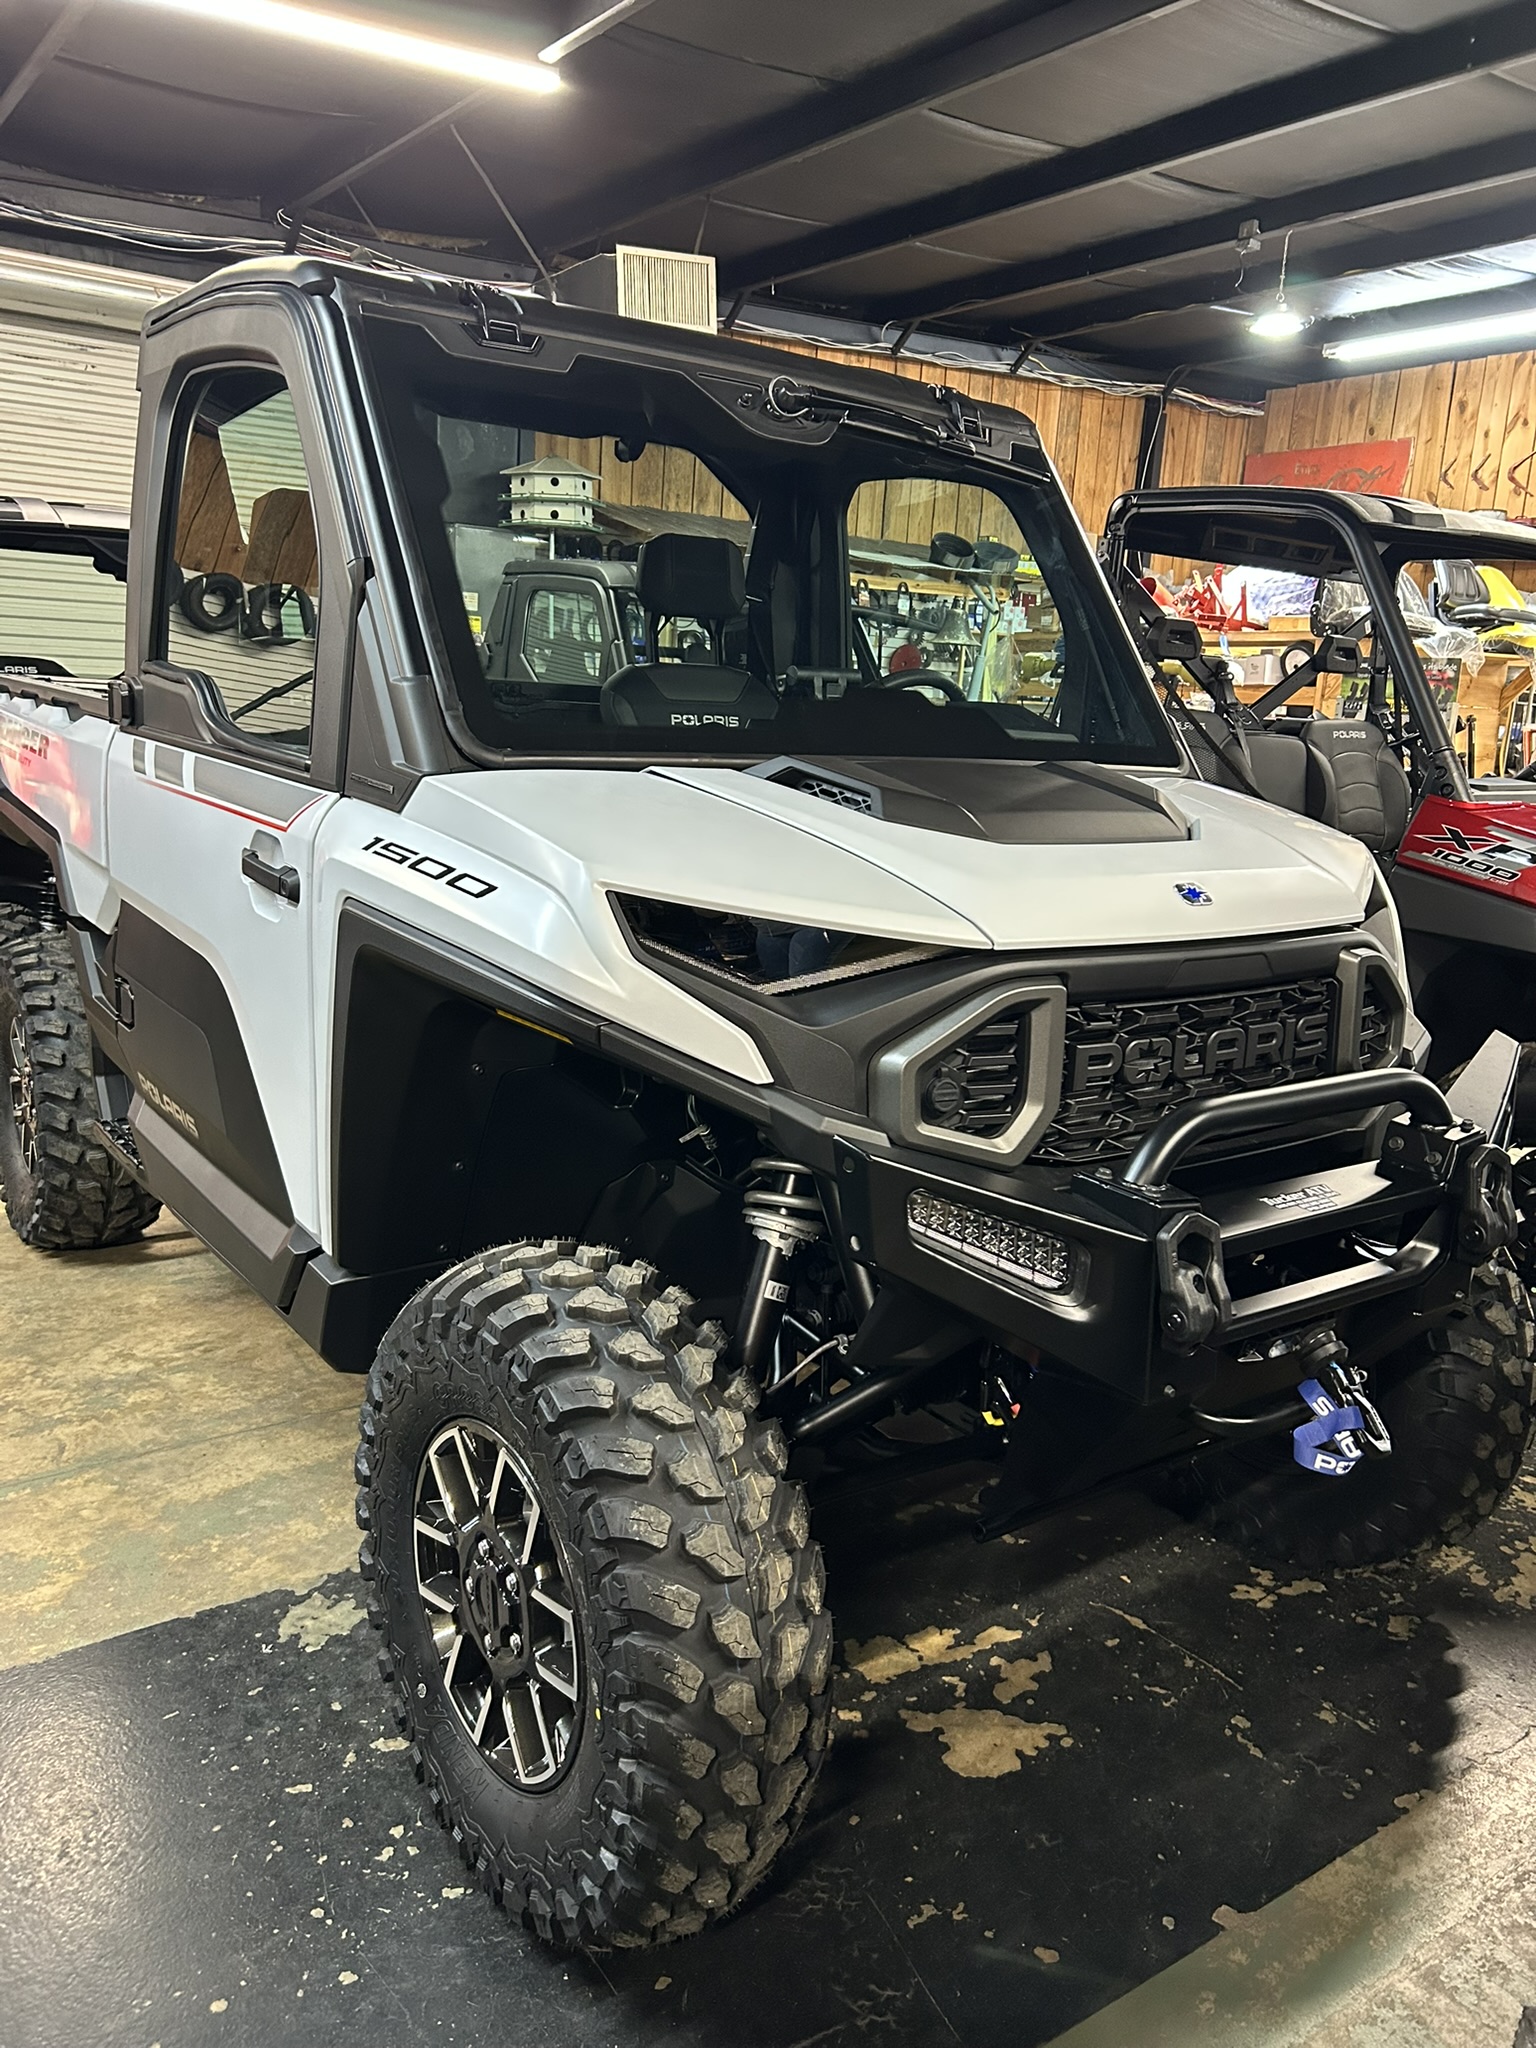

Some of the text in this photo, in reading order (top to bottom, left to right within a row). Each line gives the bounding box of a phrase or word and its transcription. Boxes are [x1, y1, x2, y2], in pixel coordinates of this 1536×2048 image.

[671, 714, 740, 728] POLARIS
[1333, 731, 1367, 739] POLARIS
[361, 836, 499, 899] 1500
[1430, 848, 1521, 882] 1000
[1073, 1013, 1329, 1091] POLARIS
[137, 1071, 199, 1139] POLARIS
